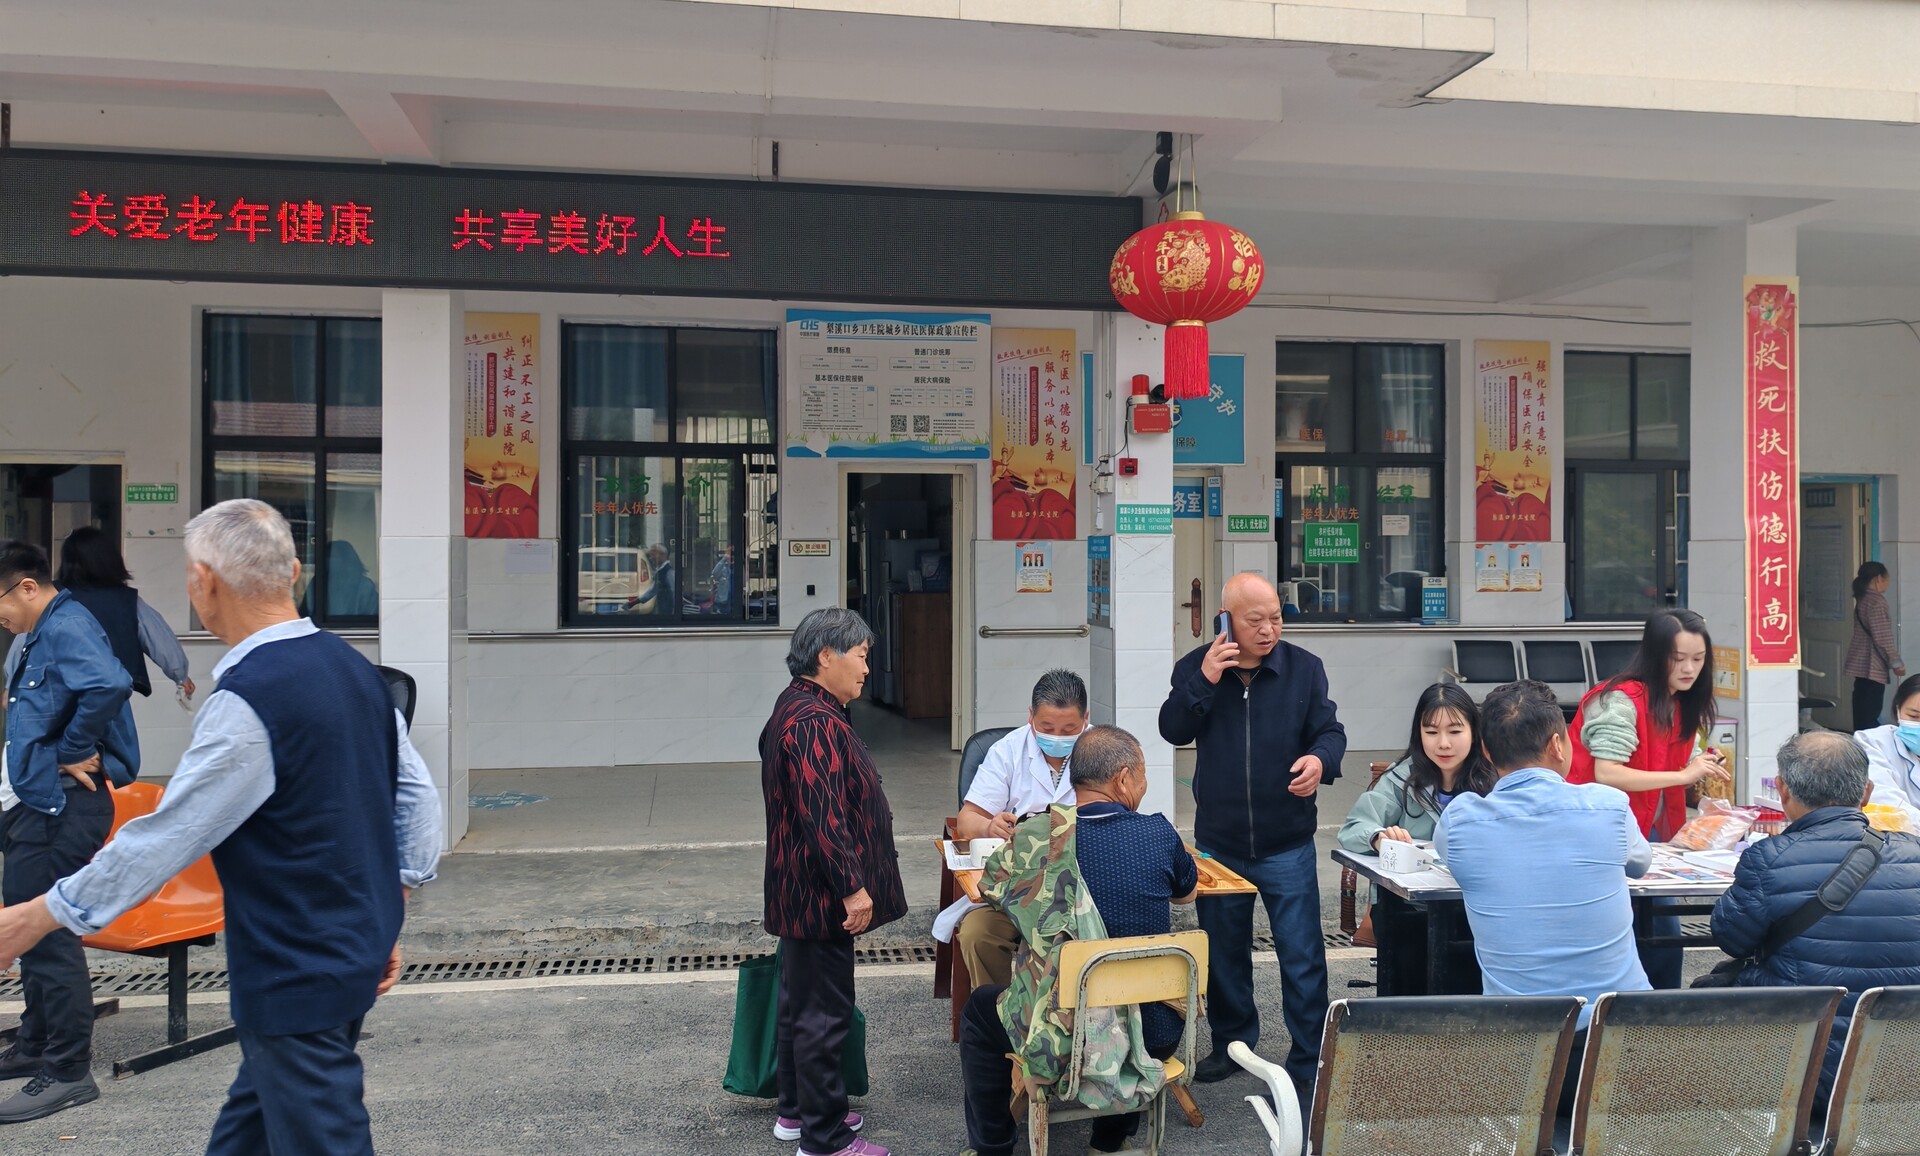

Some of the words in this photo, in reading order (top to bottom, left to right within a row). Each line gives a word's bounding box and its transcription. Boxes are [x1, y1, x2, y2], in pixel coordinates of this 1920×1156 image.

[70, 190, 375, 246] 关爱老年健康
[452, 208, 730, 258] 共享美好人生
[800, 320, 820, 331] CHS
[520, 334, 534, 444] 纠正不正之风
[815, 374, 864, 383] 基本医保住院报销
[914, 376, 951, 384] 居民大病保险
[502, 346, 517, 457] 共建和谐医院
[1043, 361, 1057, 464] 服务以诚为本
[1059, 349, 1072, 452] 行医以德为先
[1208, 383, 1237, 416] 守护
[1535, 359, 1547, 456] 强化责任意识
[1299, 428, 1324, 441] 医保
[1521, 371, 1533, 468] 确保医疗安全
[1173, 491, 1202, 513] 务室
[1376, 484, 1418, 504] 结算
[1754, 339, 1788, 632] 救死扶伤德行高
[594, 501, 658, 515] 老年人优先
[1301, 507, 1360, 519] 老年人优先
